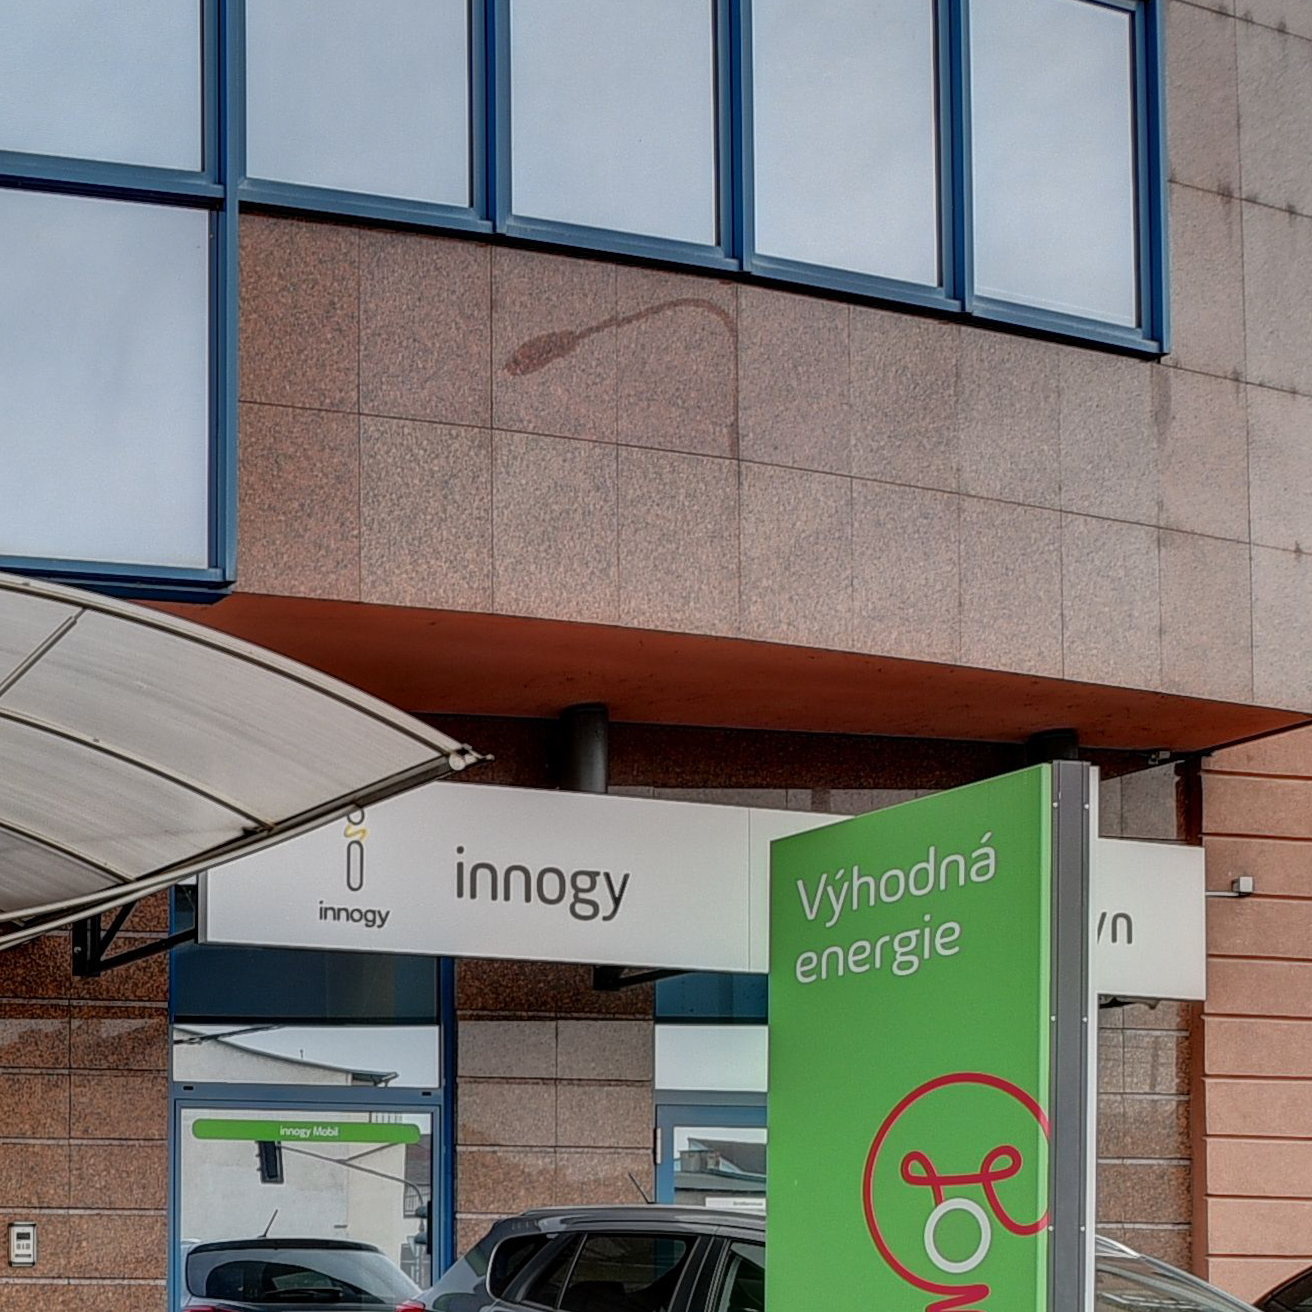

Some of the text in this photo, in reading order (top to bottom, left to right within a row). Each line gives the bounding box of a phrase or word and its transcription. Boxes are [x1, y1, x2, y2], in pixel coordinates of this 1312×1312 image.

[318, 900, 390, 928] innogy
[456, 846, 630, 921] innogy
[796, 831, 996, 928] Výhodná
[795, 914, 961, 984] energie
[279, 1126, 339, 1138] innogy Mobil
